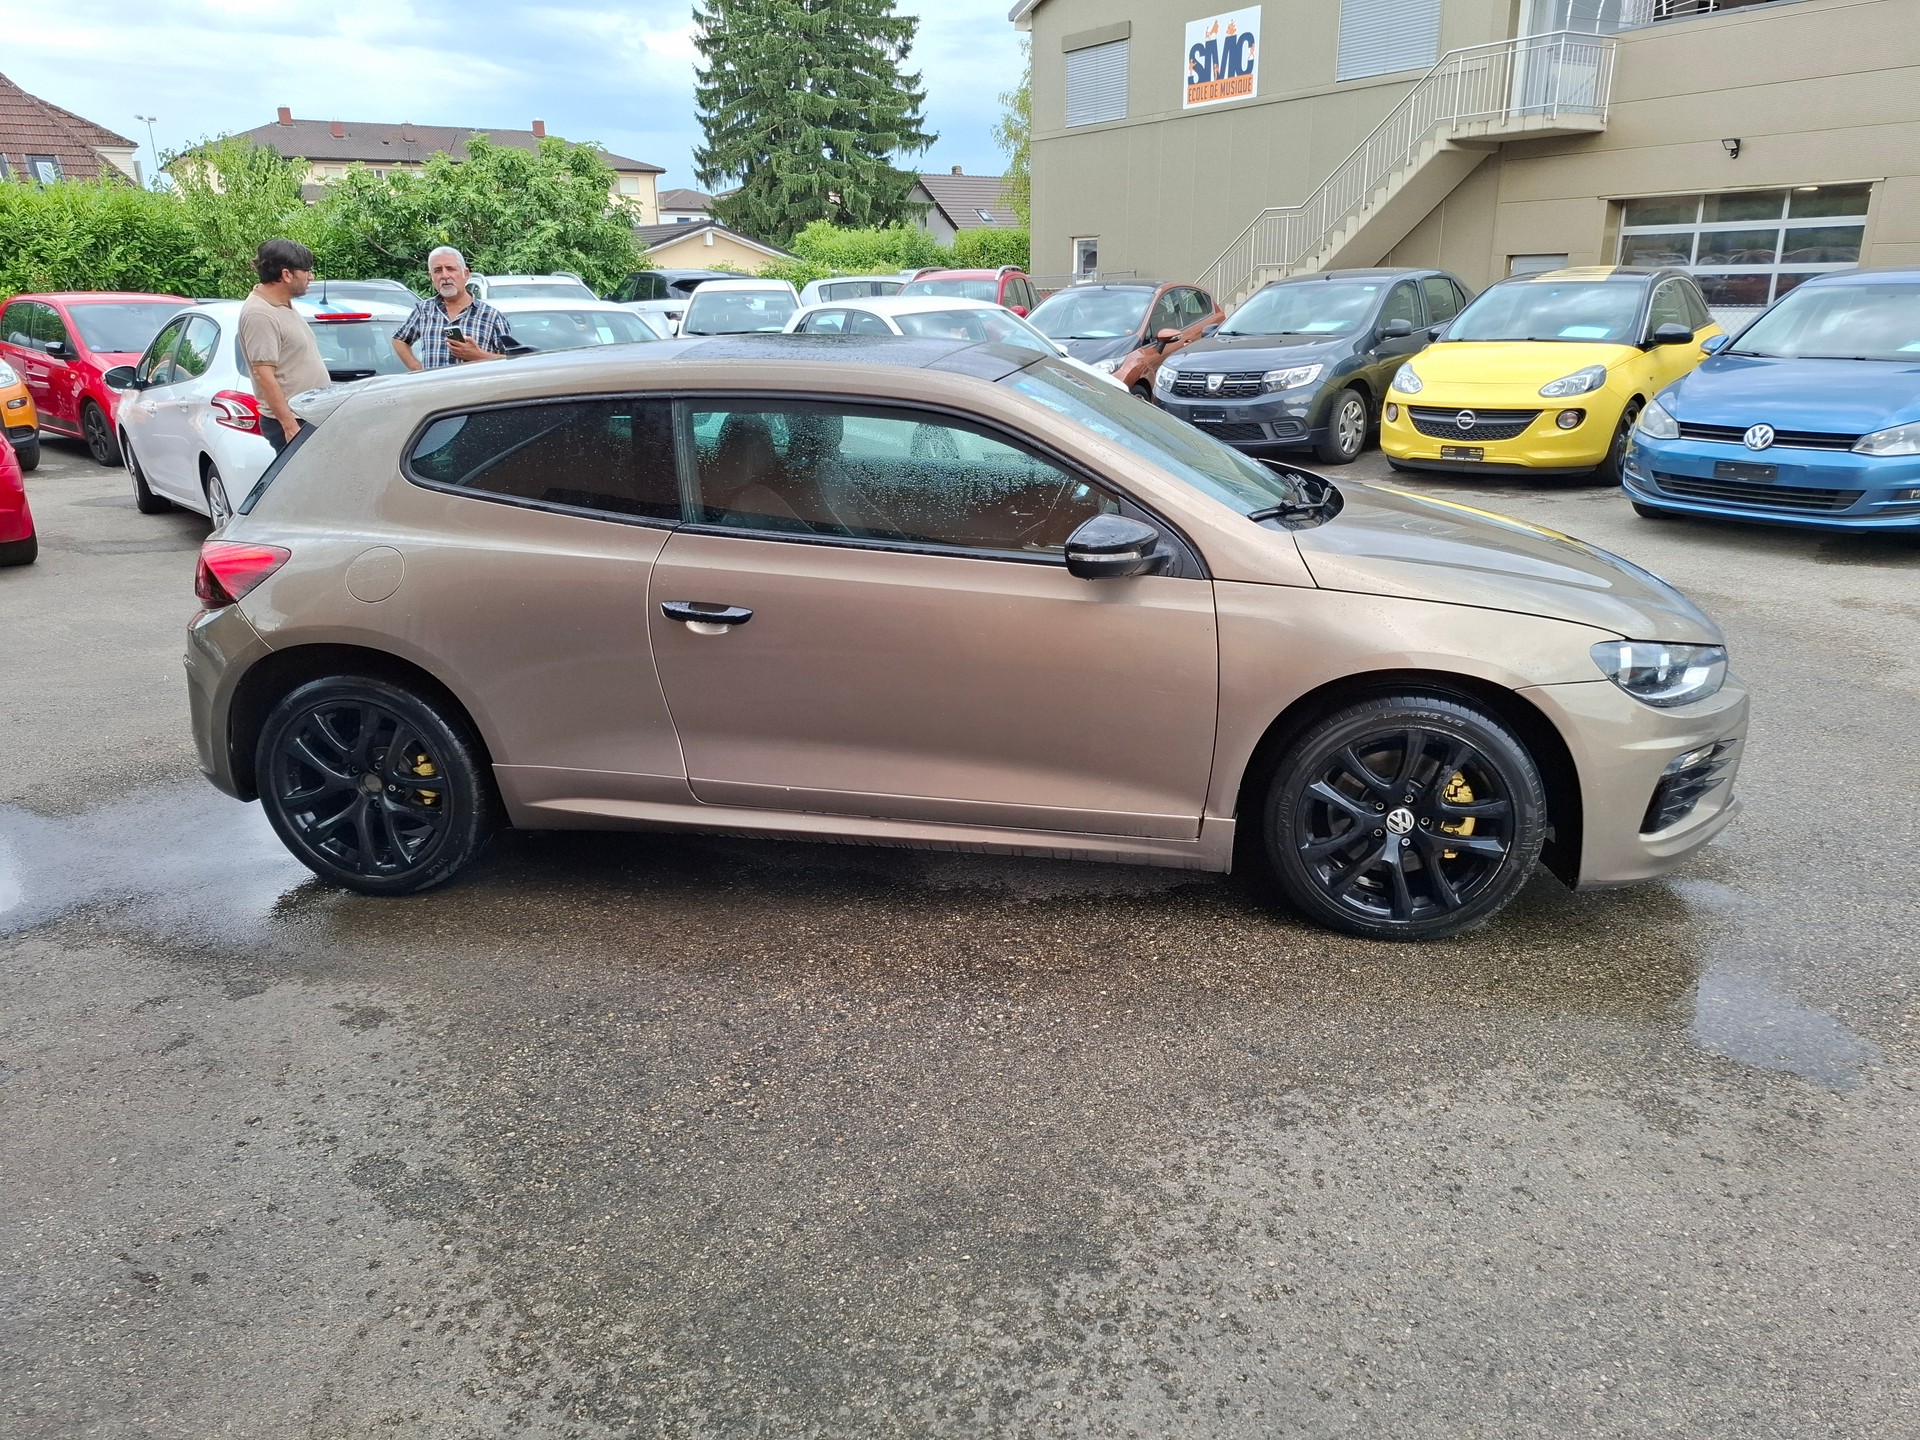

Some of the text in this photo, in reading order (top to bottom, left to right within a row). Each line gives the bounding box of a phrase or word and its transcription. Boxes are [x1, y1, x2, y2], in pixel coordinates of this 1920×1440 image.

[1188, 32, 1255, 85] SMC
[1188, 77, 1252, 102] ECOLE DE MUSIQUE
[1743, 424, 1774, 450] VW
[1386, 808, 1415, 835] VW
